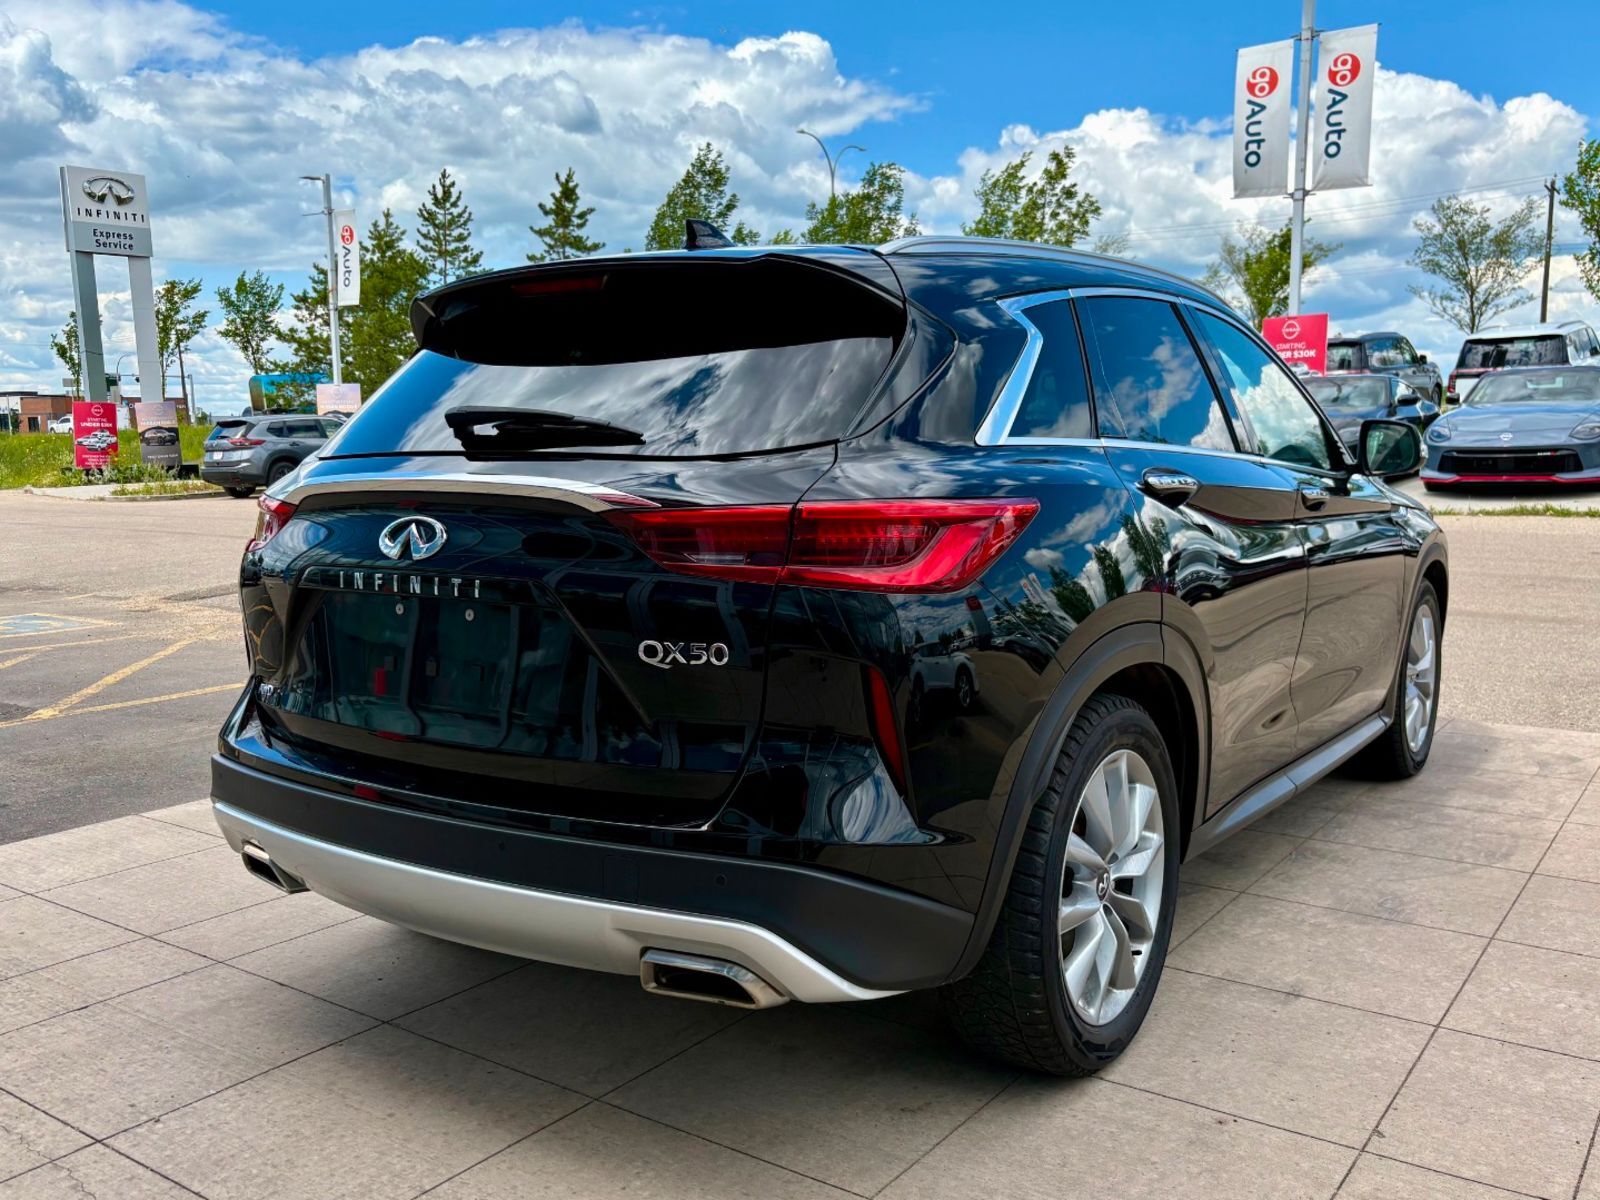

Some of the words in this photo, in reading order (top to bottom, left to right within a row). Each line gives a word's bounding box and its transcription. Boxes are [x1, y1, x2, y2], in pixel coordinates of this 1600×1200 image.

[1247, 67, 1273, 98] go
[1330, 53, 1355, 87] go
[1244, 99, 1267, 168] Auto
[1324, 88, 1348, 159] Auto
[77, 207, 145, 223] INFINITI
[92, 228, 134, 240] Express
[95, 239, 134, 251] Service
[342, 245, 352, 287] Auto
[339, 570, 481, 598] INFINITI
[638, 640, 729, 669] QX50
